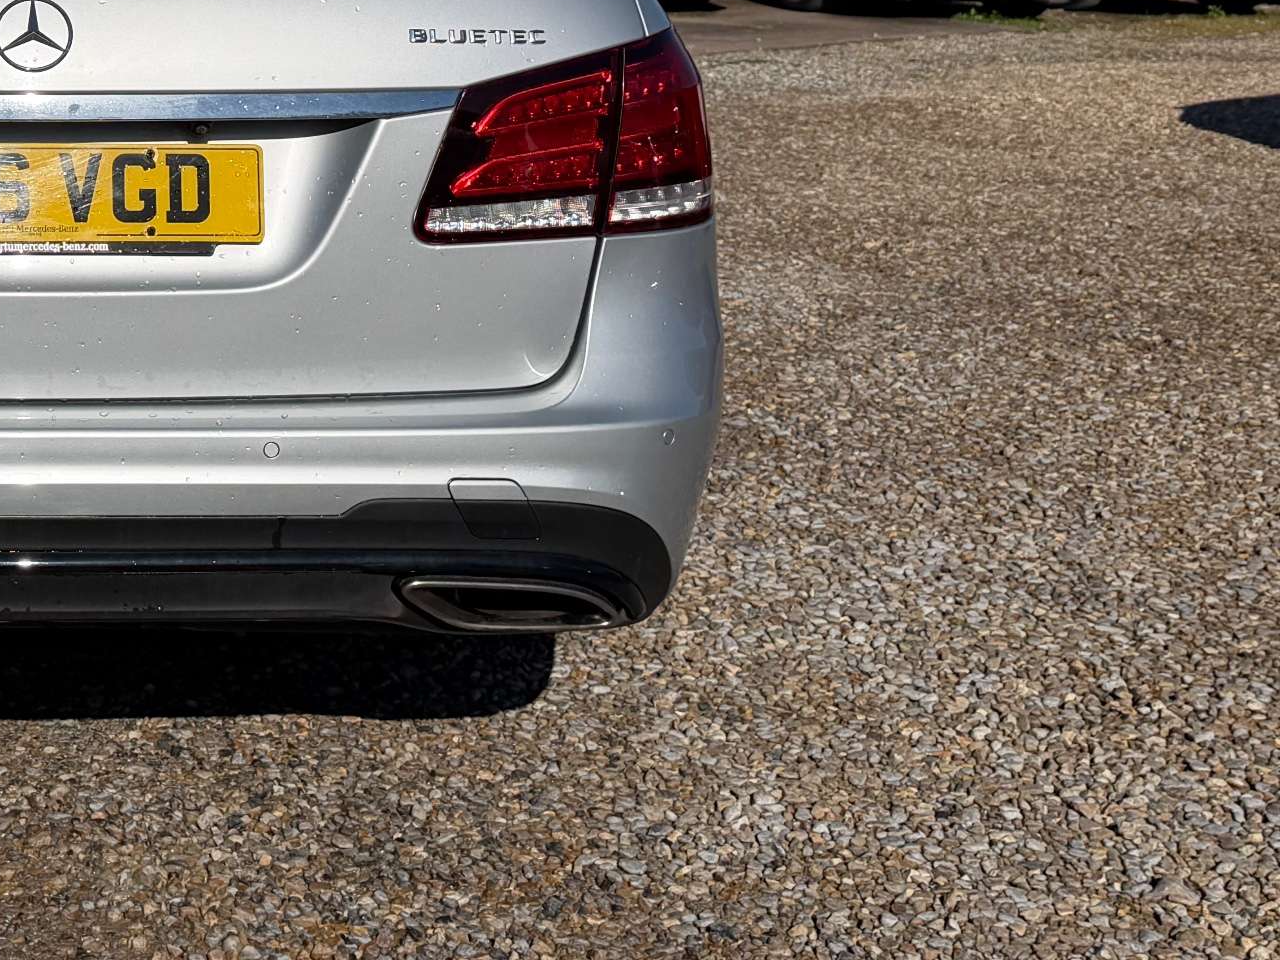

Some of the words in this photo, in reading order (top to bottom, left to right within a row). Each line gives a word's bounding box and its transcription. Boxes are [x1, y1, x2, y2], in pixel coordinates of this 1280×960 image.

[408, 28, 547, 45] BLUETEC
[58, 152, 210, 223] VGD
[16, 224, 80, 233] Mercedes-Benz
